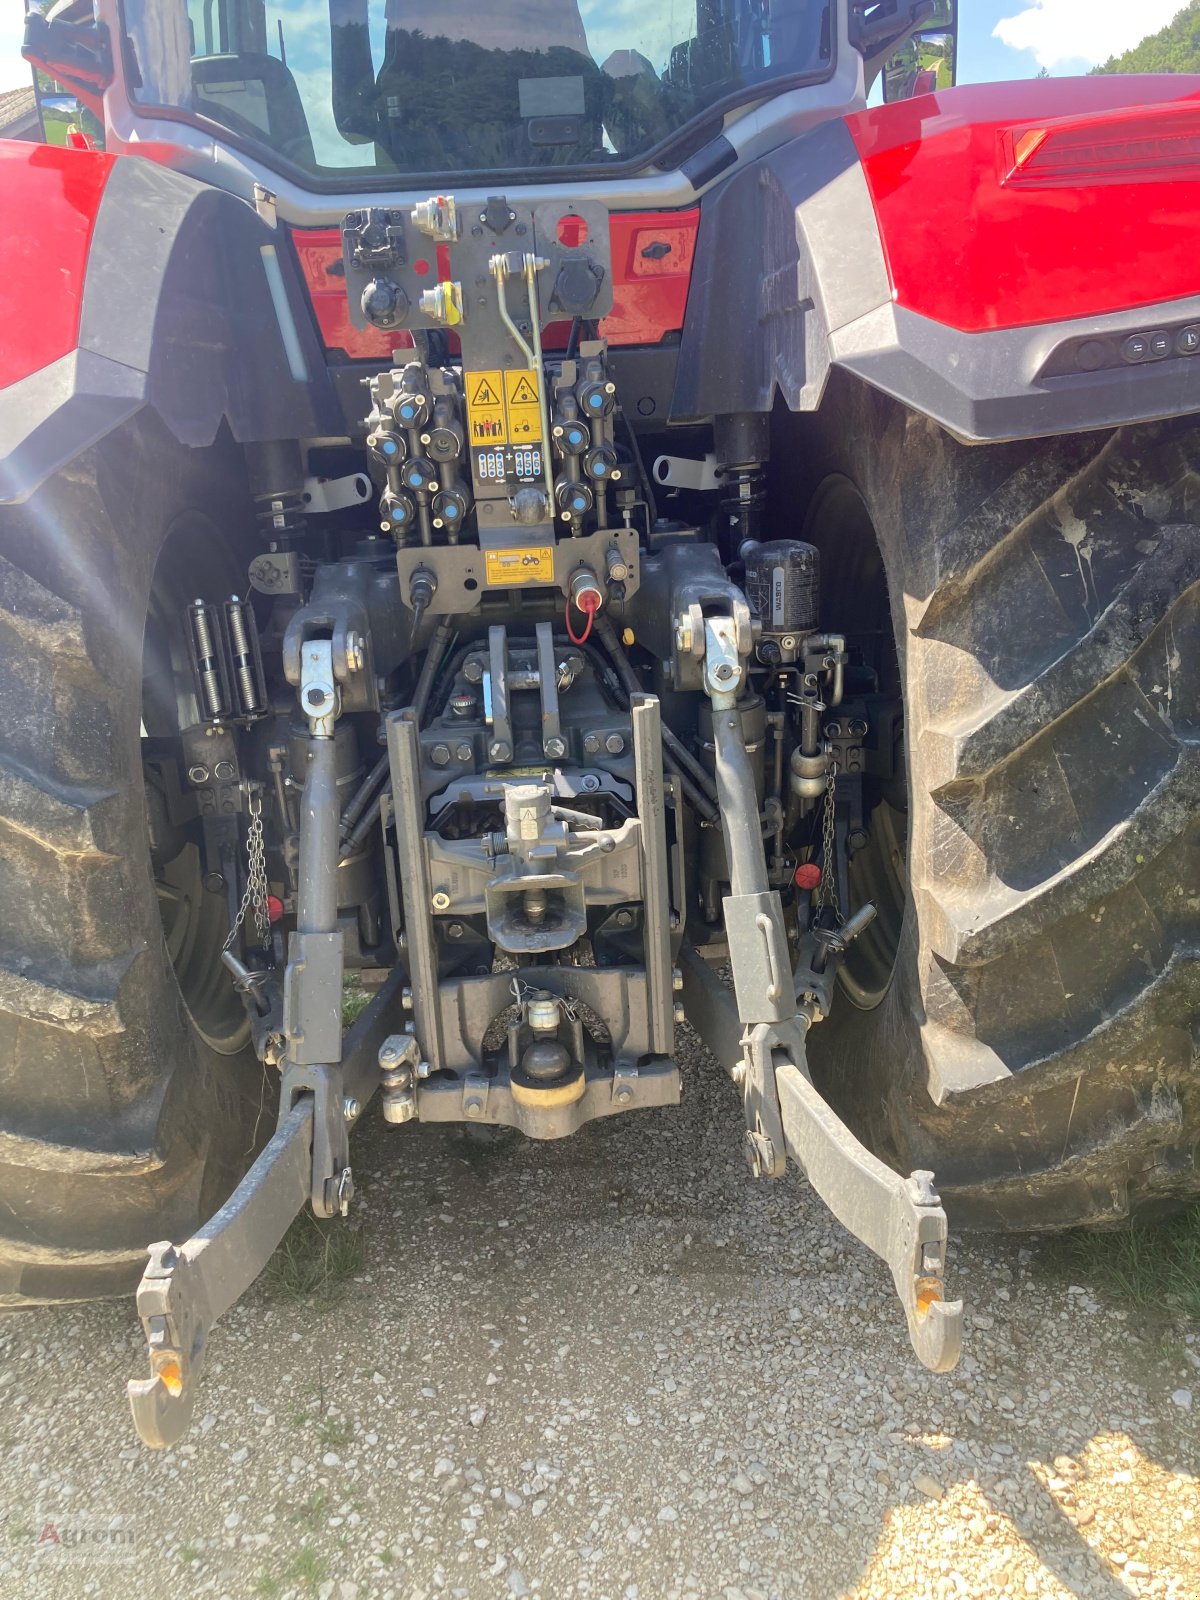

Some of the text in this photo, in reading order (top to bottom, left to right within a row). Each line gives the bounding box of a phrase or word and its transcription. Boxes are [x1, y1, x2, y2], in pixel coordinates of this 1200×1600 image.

[489, 461, 495, 470] 2
[497, 460, 503, 469] 3
[517, 459, 540, 468] 4 5 6
